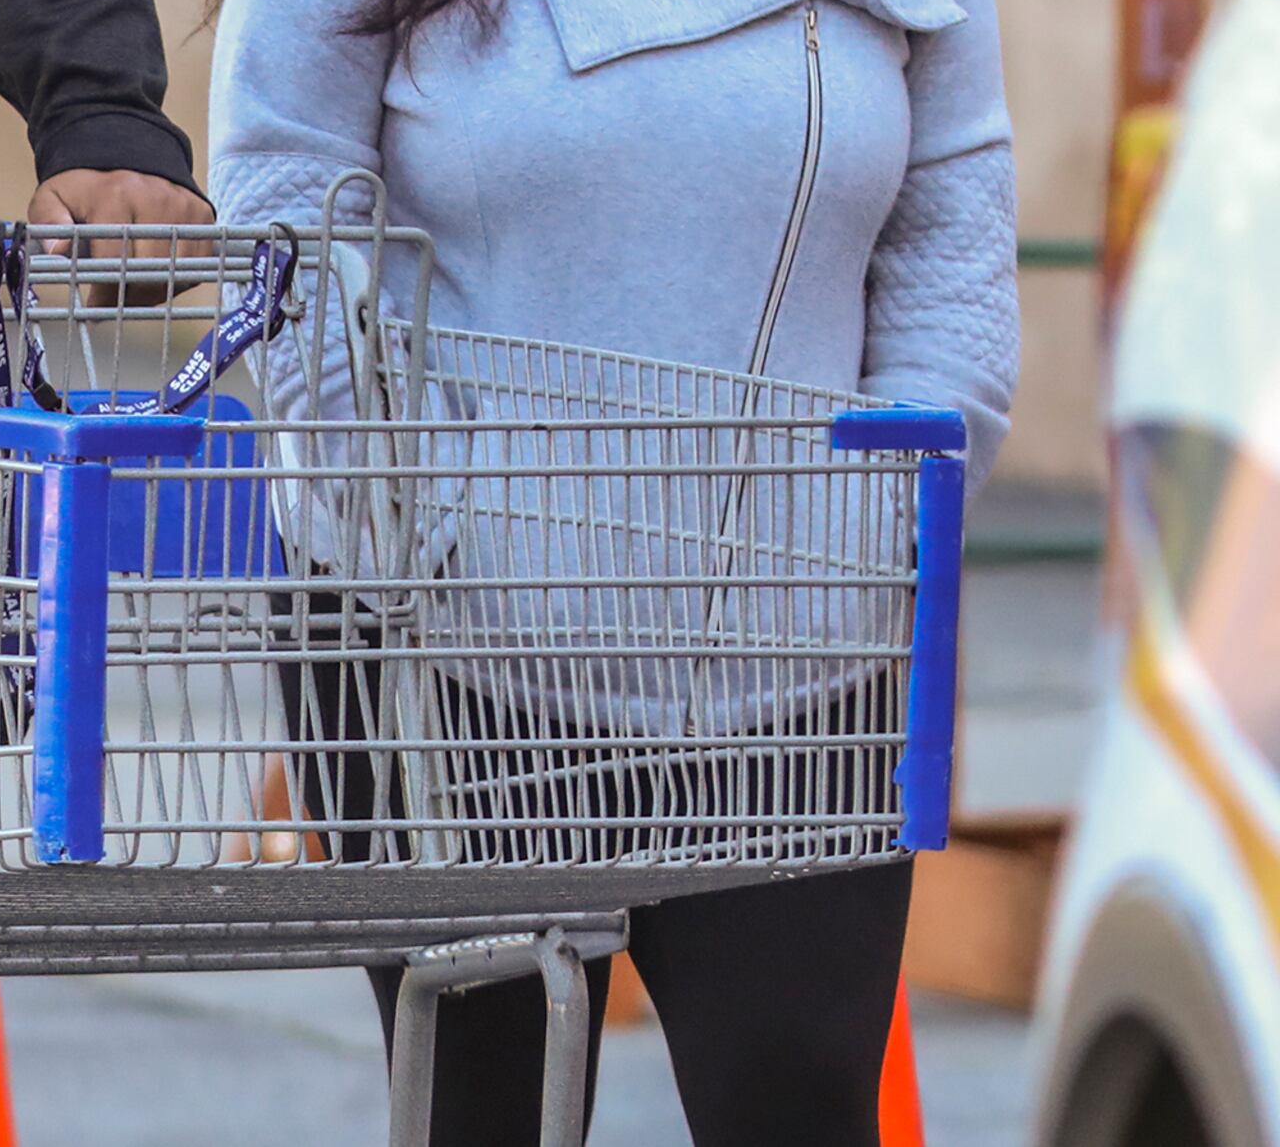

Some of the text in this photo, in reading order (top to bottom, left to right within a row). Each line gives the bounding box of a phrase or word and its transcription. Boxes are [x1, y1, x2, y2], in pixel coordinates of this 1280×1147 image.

[255, 255, 267, 278] Use
[169, 350, 205, 391] SAMS
[179, 361, 211, 393] CLUB
[134, 399, 157, 410] Use
